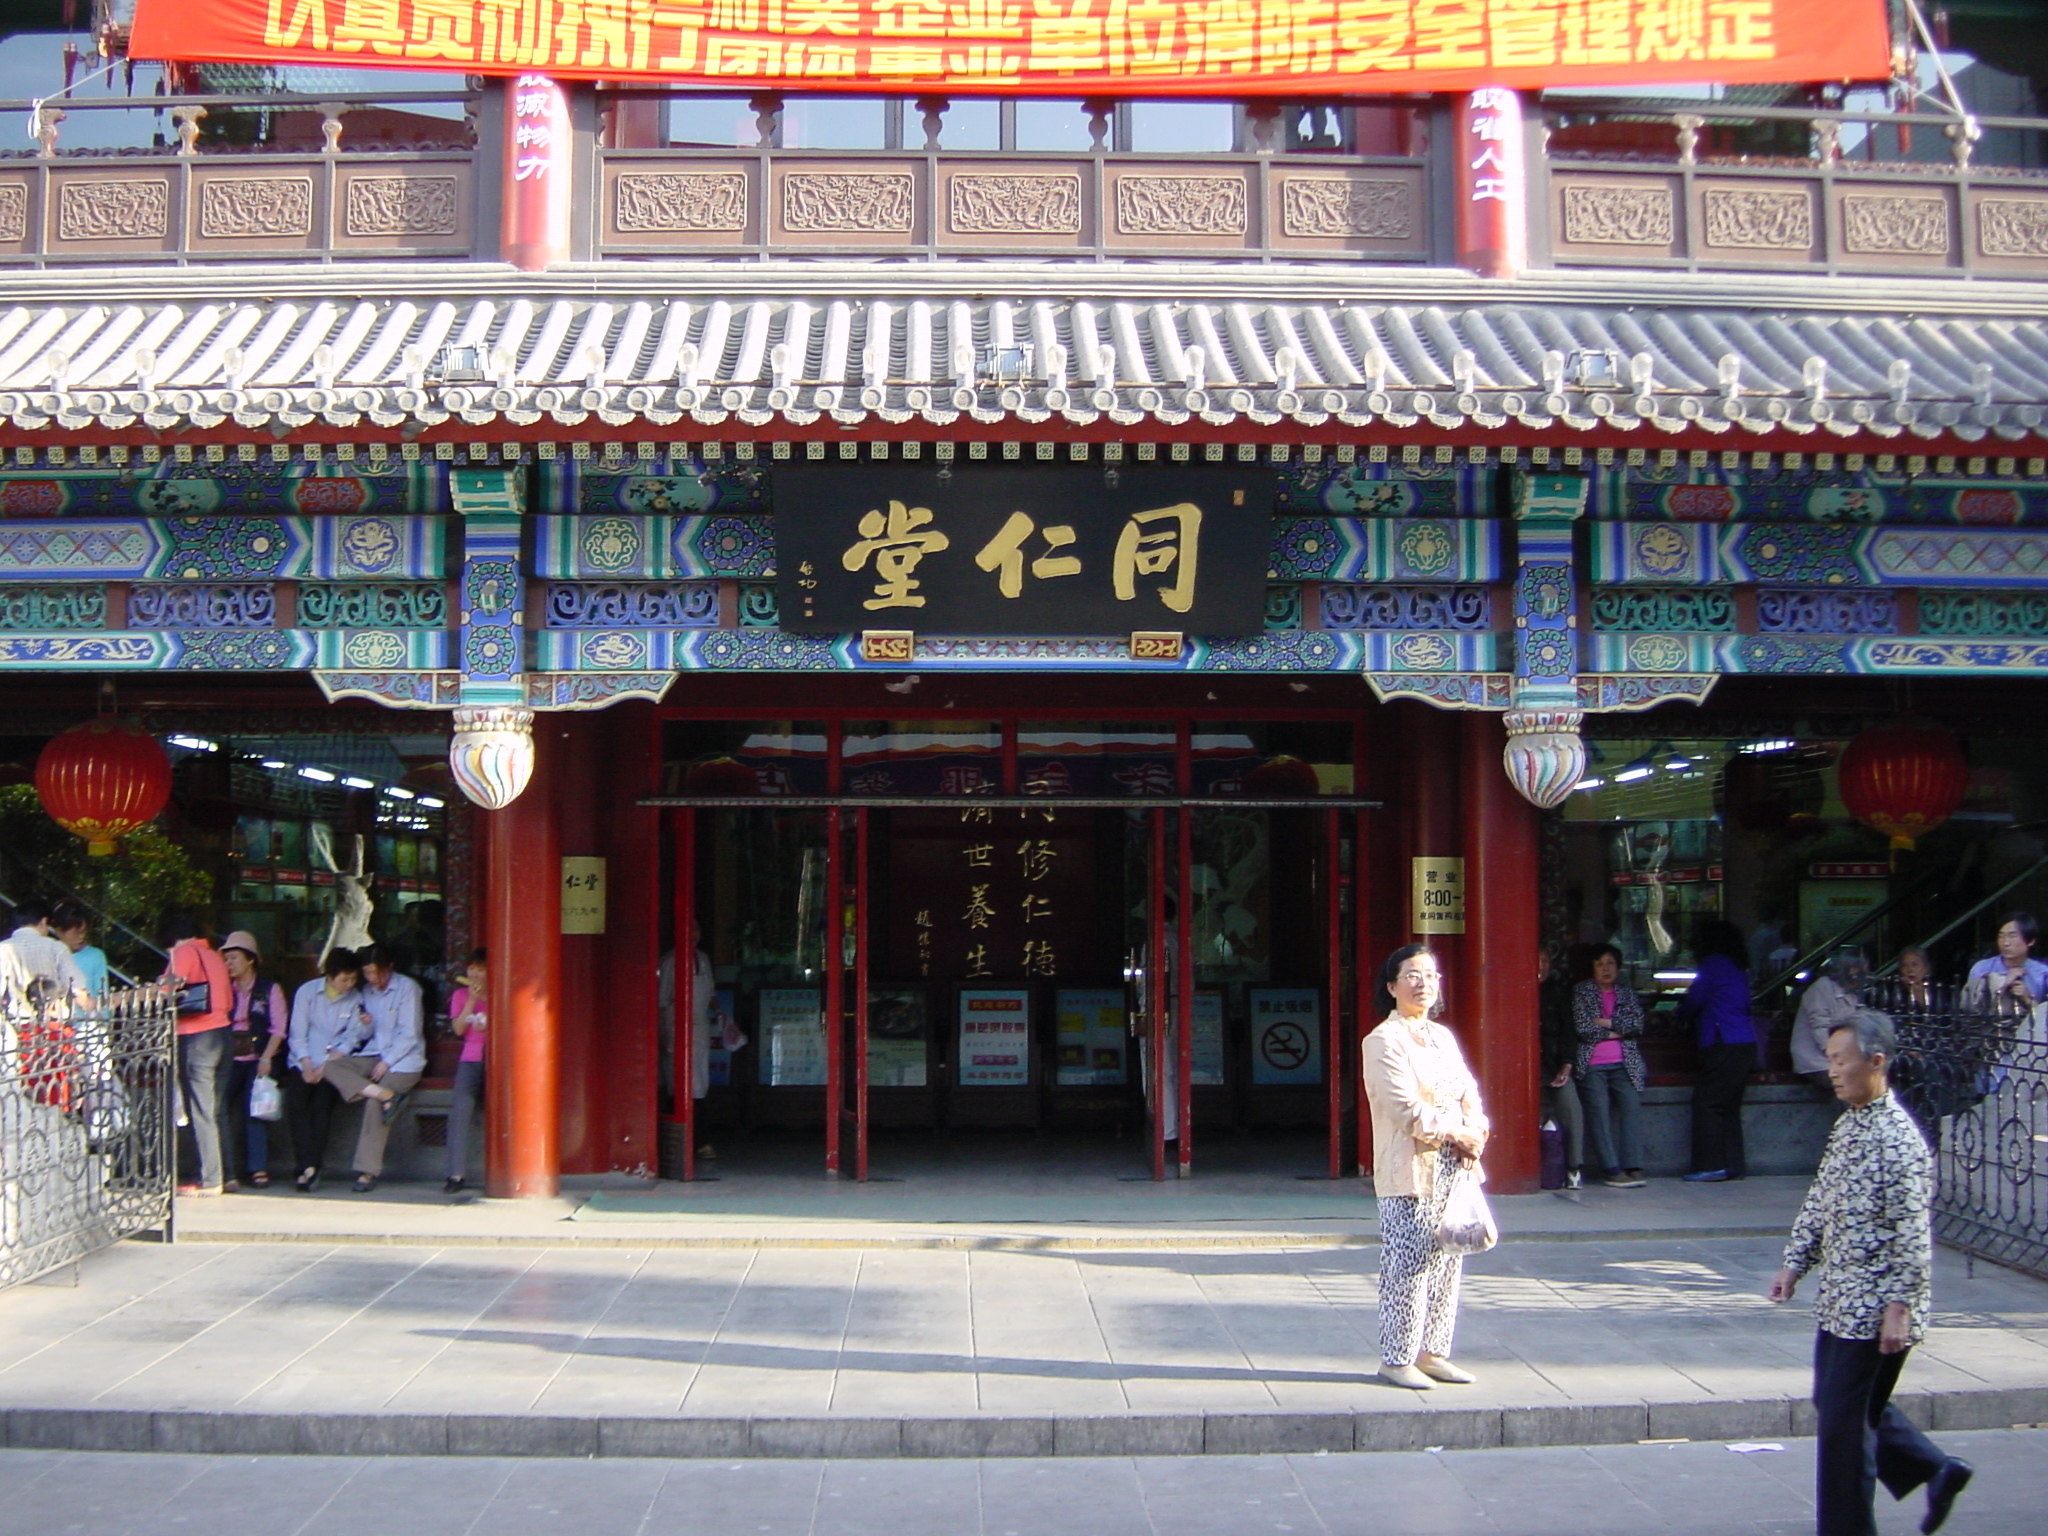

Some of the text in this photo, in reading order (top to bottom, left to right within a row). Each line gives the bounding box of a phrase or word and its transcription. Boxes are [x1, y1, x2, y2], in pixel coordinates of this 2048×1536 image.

[842, 499, 1203, 614] 同仁堂
[1426, 870, 1458, 883] 营业
[1258, 999, 1313, 1014] 禁止吸烟
